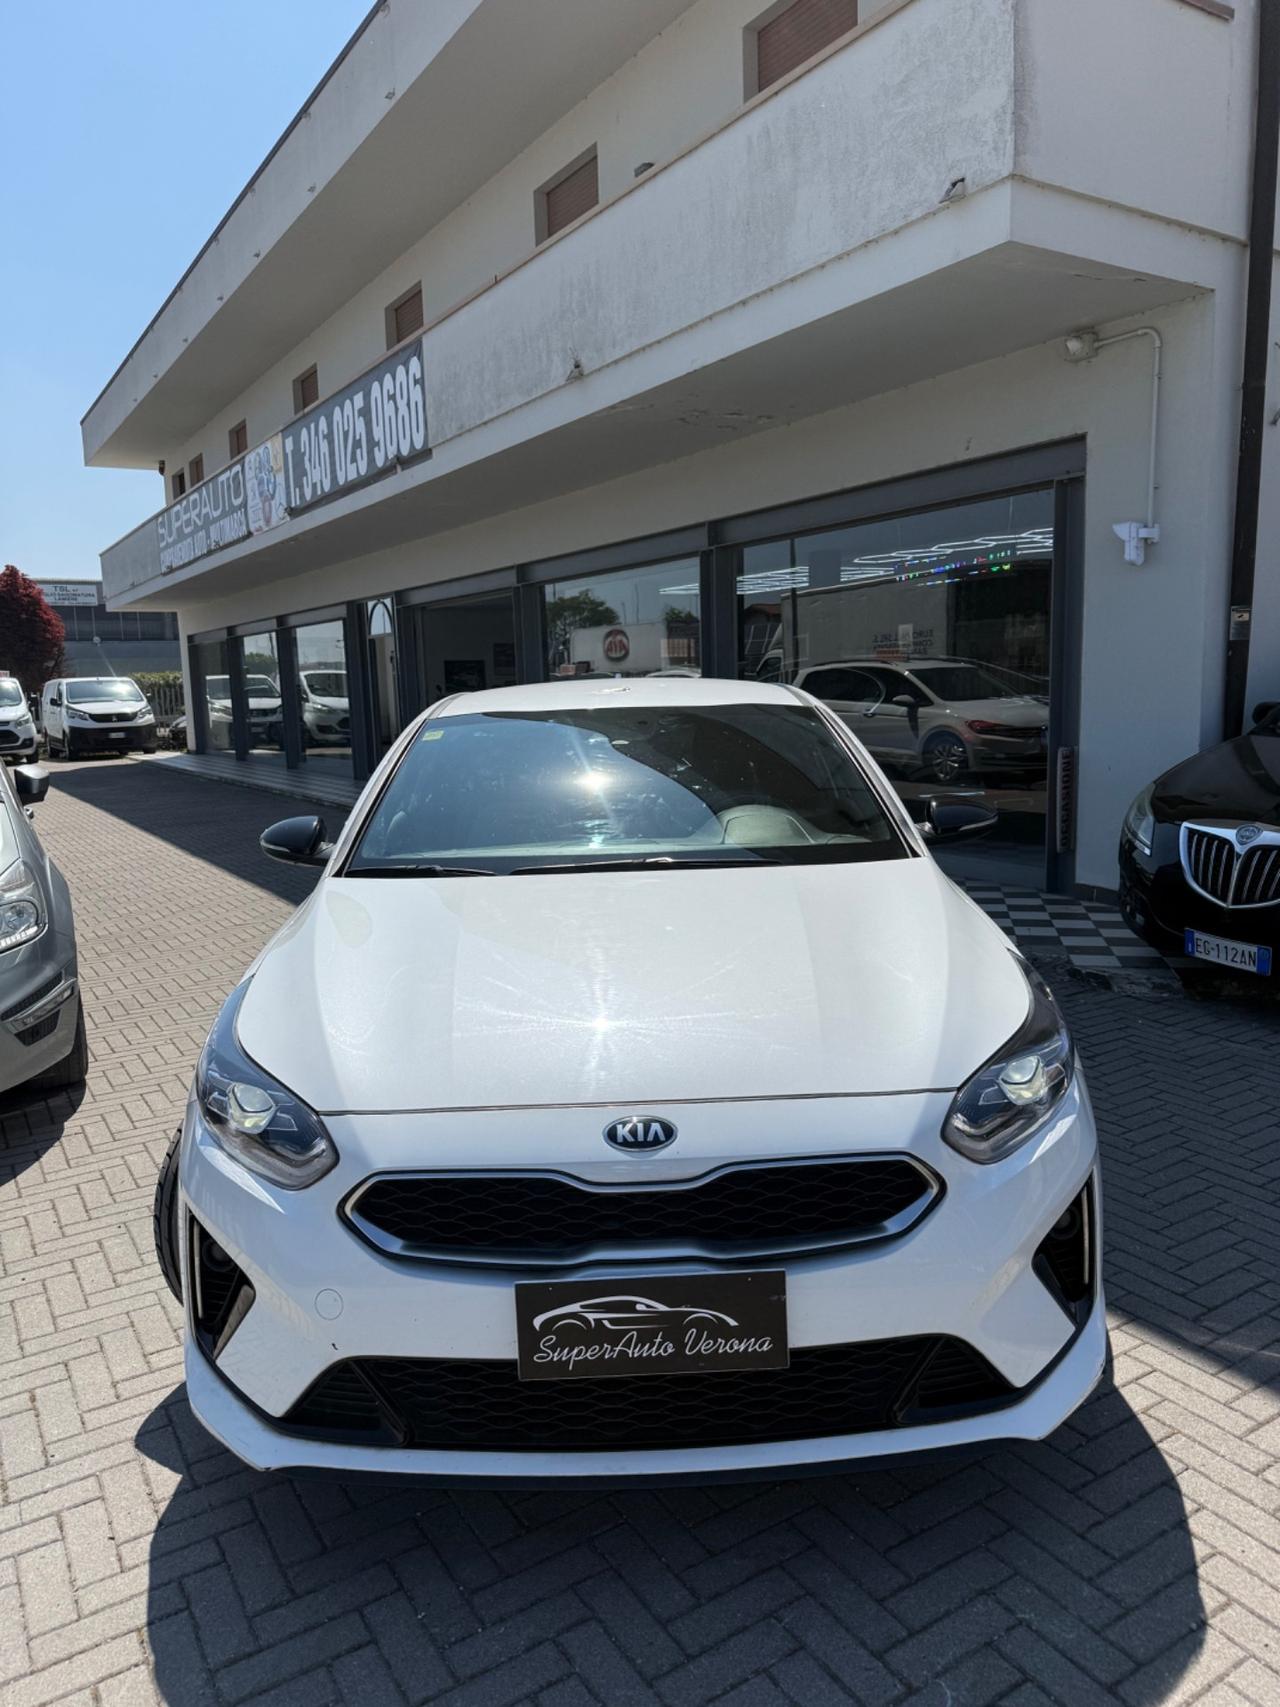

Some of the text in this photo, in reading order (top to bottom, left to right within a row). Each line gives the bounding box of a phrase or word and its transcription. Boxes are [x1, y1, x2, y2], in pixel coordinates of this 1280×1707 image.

[301, 416, 331, 501] 346
[333, 391, 367, 485] 025
[370, 356, 424, 467] 9686
[157, 464, 246, 548] SUPERAUTO
[616, 1122, 666, 1143] KIA
[533, 1328, 773, 1371] SuperAuto Verona
